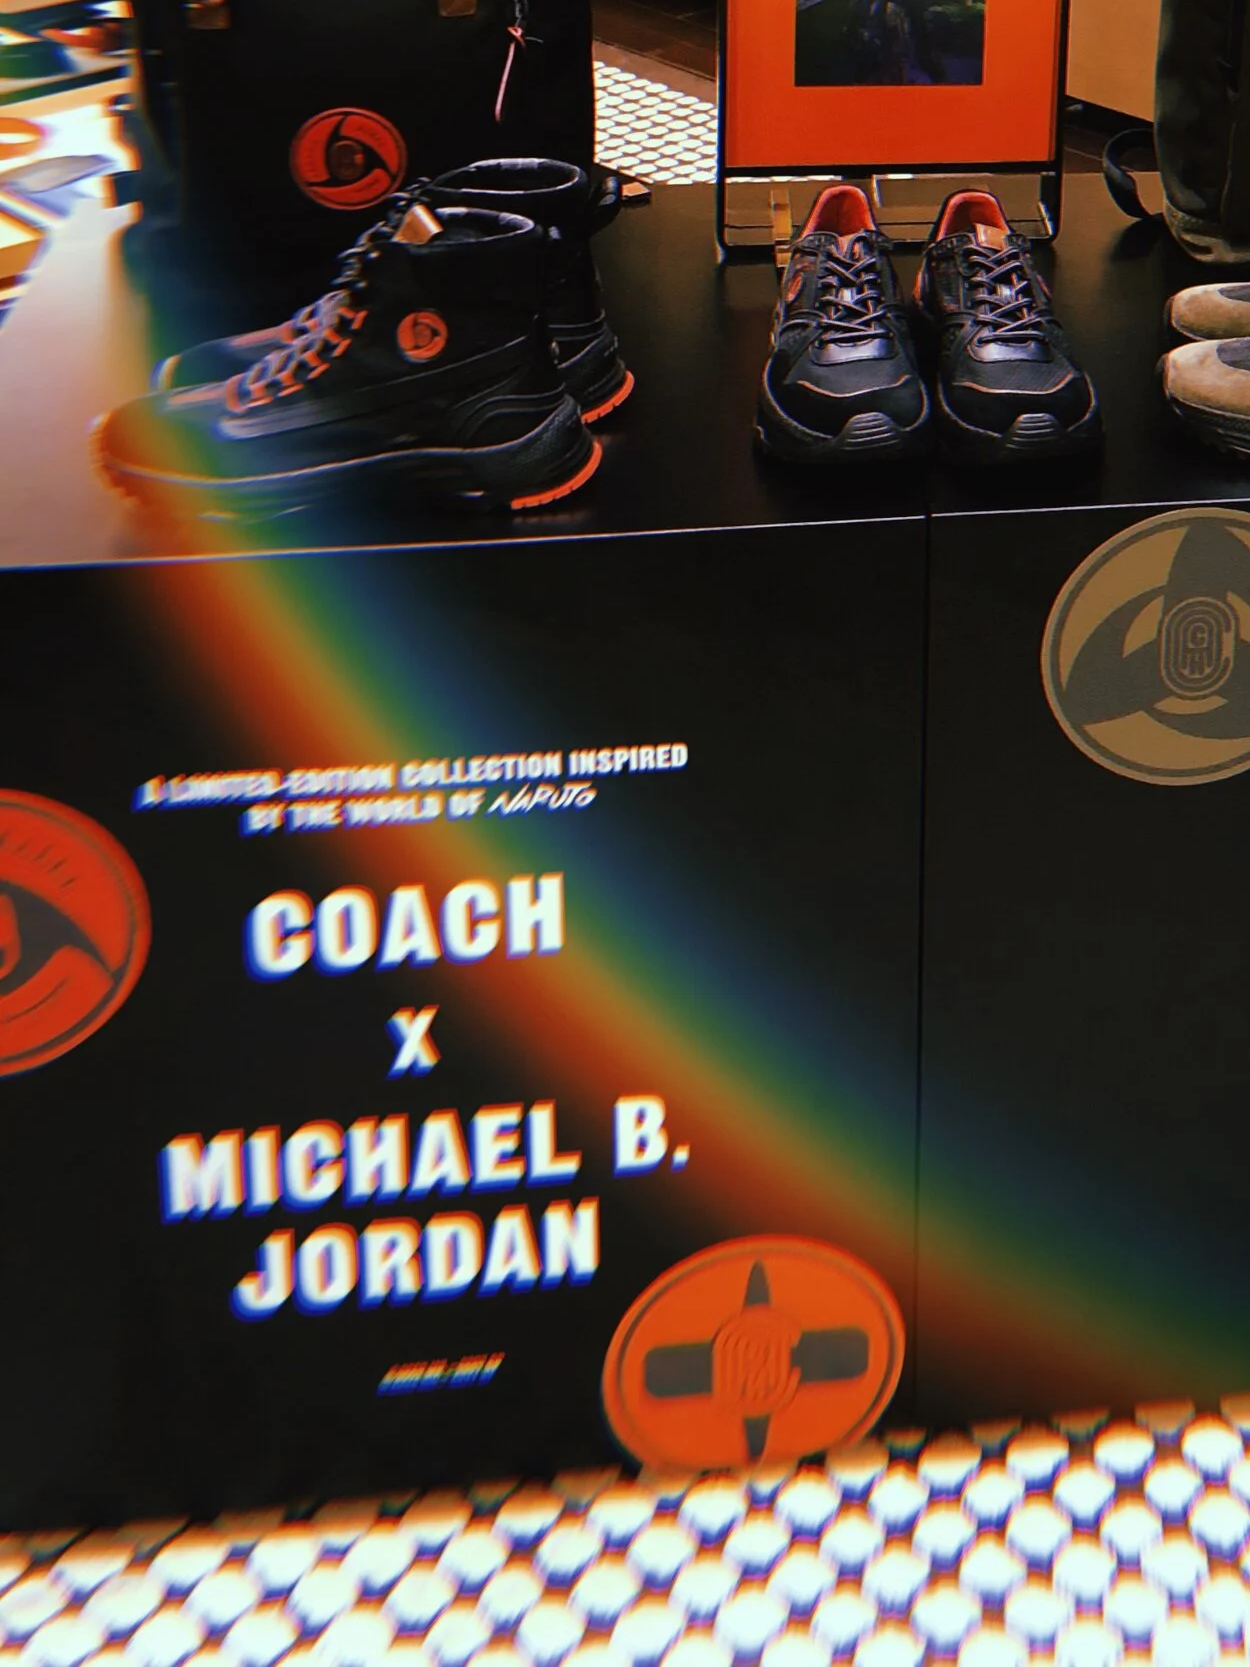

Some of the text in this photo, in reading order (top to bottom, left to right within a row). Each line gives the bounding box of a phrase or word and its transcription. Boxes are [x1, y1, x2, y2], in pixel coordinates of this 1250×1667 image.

[286, 798, 343, 833] THE
[345, 790, 444, 829] WORLD
[447, 787, 486, 821] OF
[399, 750, 562, 789] COLLECTION
[569, 742, 688, 777] INSPIRED
[244, 872, 565, 980] COACH
[160, 1094, 691, 1221] MICHAEL B.
[232, 1197, 600, 1319] JORDAN
